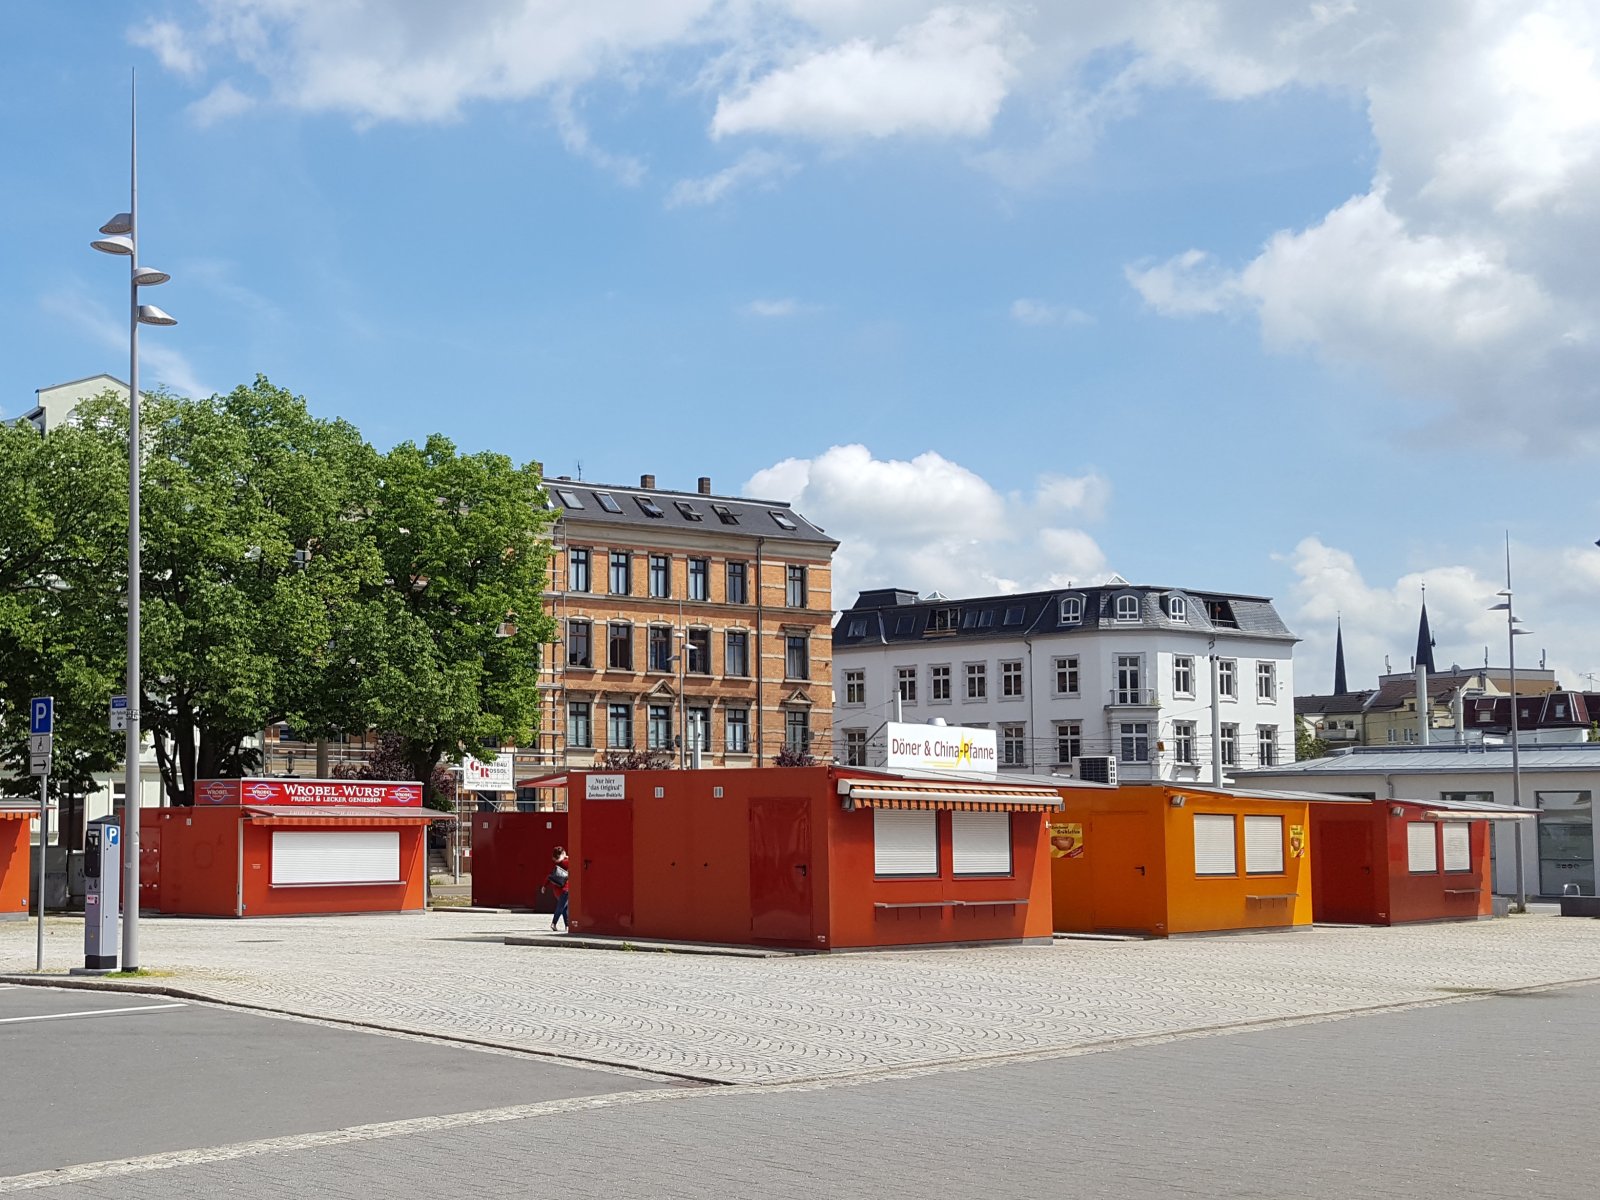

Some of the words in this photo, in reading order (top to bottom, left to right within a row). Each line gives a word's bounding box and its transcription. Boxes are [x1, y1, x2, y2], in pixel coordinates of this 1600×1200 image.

[36, 702, 47, 729] P
[892, 738, 921, 756] Döner
[924, 740, 931, 756] &
[934, 741, 994, 760] China-Pfanne
[283, 783, 387, 797] WROBEL-WURST
[109, 827, 117, 842] P
